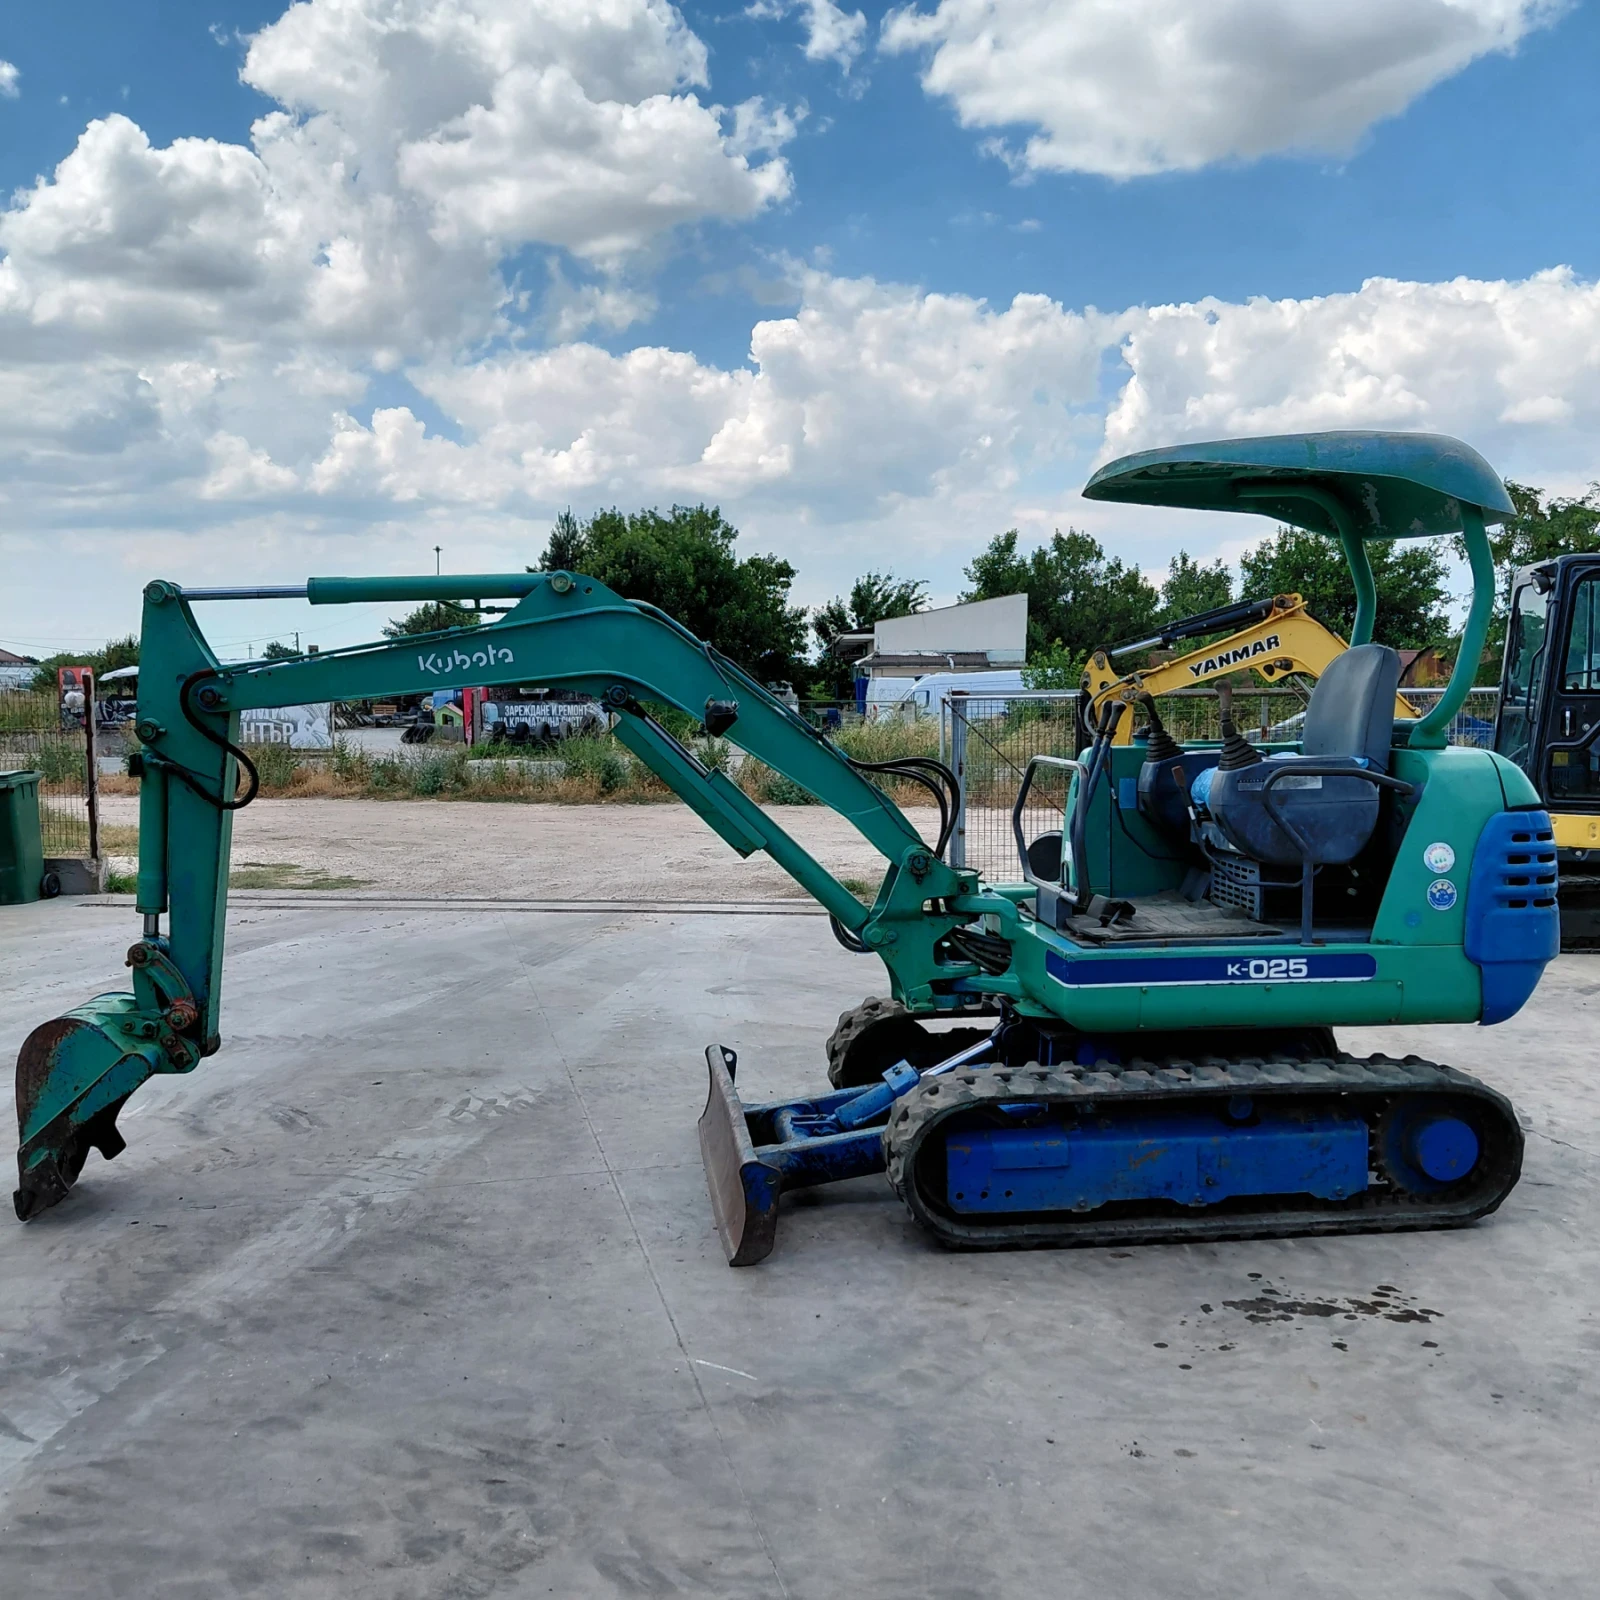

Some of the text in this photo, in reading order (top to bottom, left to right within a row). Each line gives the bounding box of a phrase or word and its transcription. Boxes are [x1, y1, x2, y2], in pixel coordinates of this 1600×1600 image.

[418, 644, 514, 675] Kubota
[1188, 634, 1280, 677] YANMAR
[504, 704, 550, 717] ЗАРЕЖДАНЕ
[558, 704, 588, 716] РЕМОНТ
[239, 722, 294, 743] НТЪР
[1227, 958, 1308, 978] K-025
